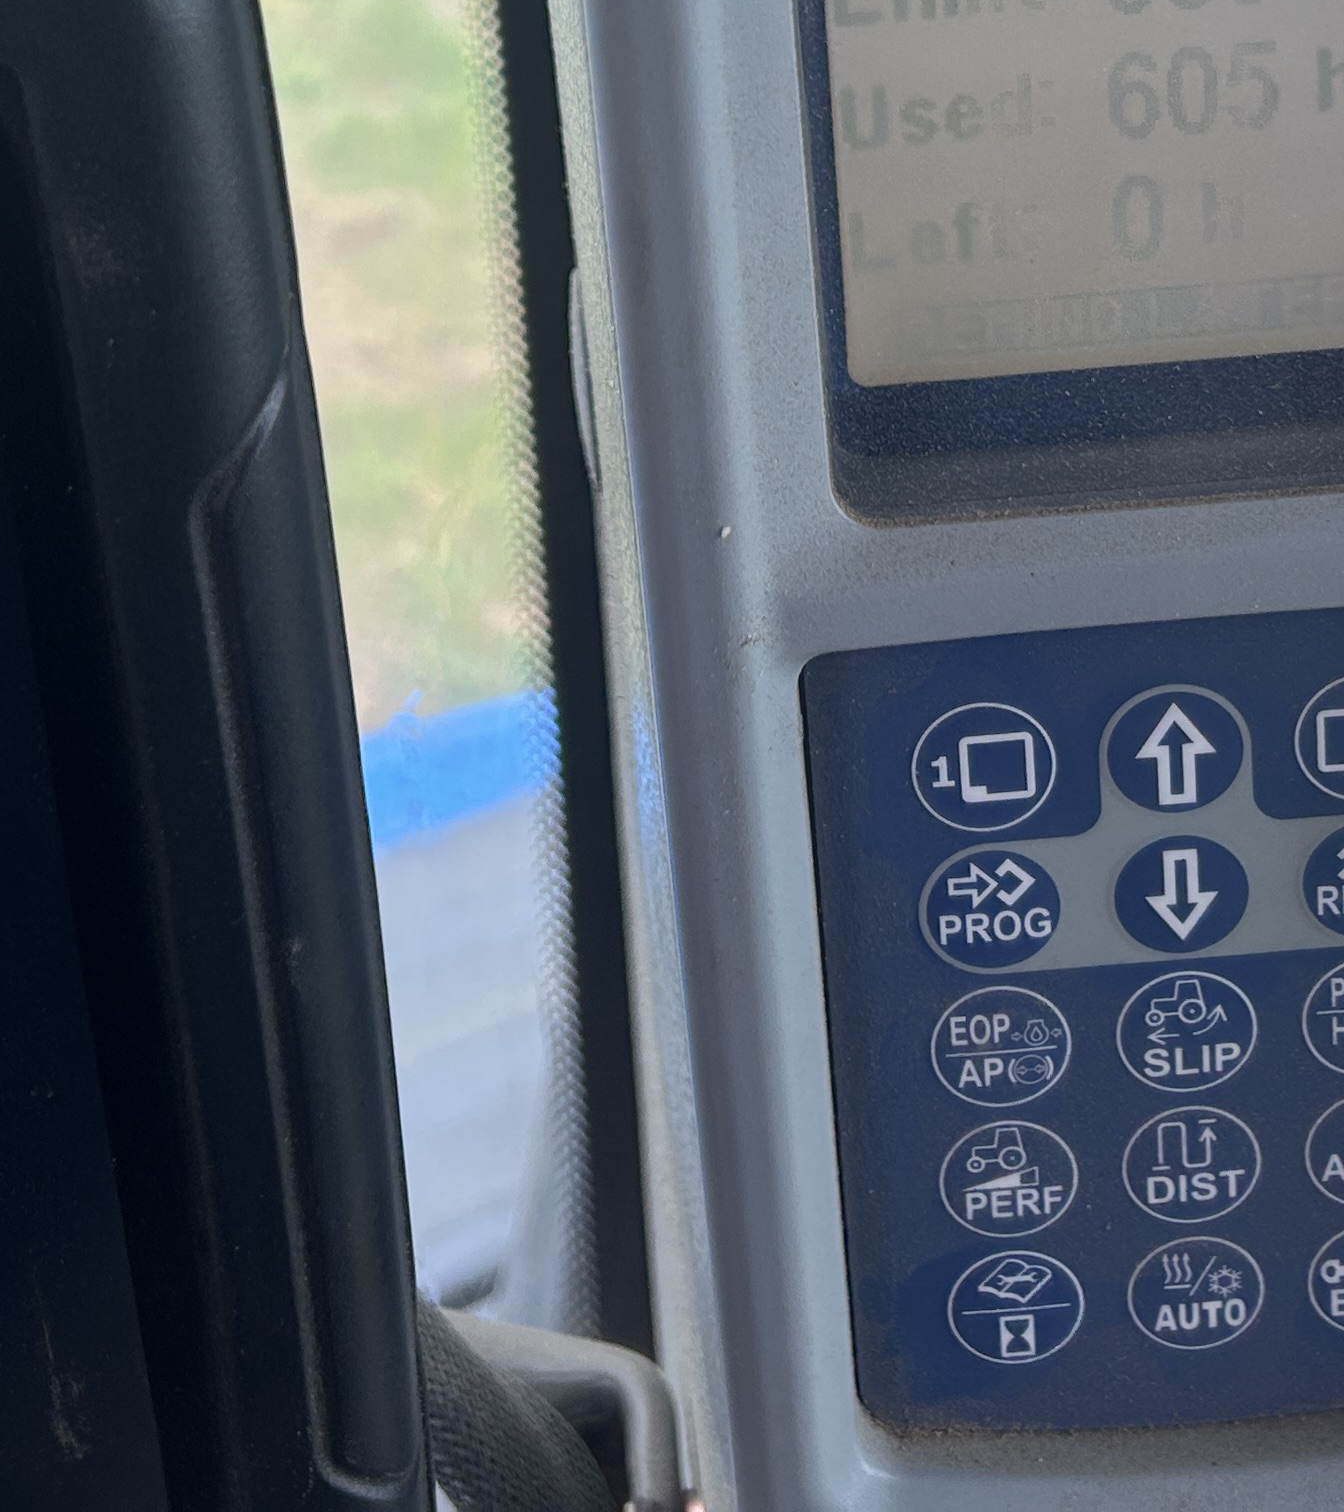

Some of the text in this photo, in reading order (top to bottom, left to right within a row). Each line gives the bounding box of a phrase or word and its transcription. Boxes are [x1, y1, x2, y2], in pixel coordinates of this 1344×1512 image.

[839, 71, 1056, 152] Used:
[1105, 40, 1279, 140] 605
[1112, 173, 1164, 262] 0
[931, 756, 955, 787] 1
[939, 909, 1053, 945] PROG
[949, 1014, 1010, 1047] EOP
[958, 1056, 1005, 1088] AP
[1143, 1042, 1241, 1078] SLIP
[966, 1187, 1063, 1220] PERF
[1146, 1169, 1245, 1205] DIST
[1155, 1298, 1247, 1332] AUTO
